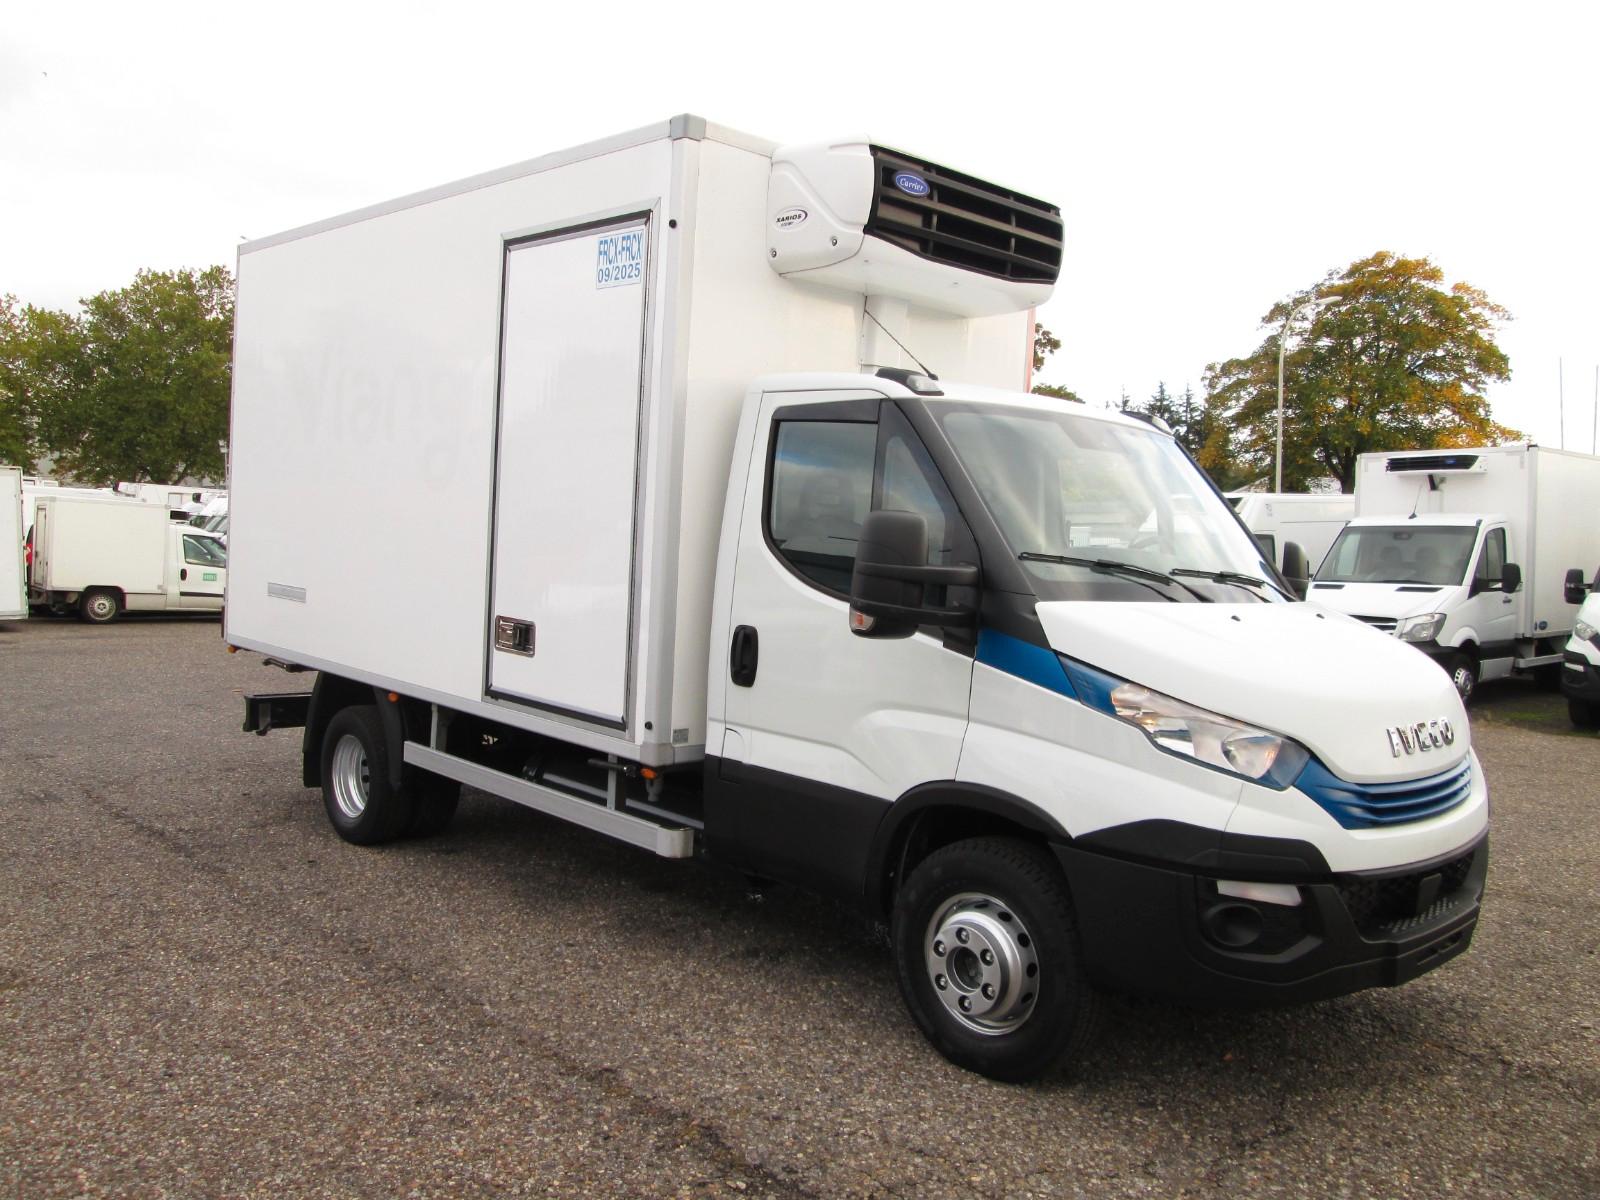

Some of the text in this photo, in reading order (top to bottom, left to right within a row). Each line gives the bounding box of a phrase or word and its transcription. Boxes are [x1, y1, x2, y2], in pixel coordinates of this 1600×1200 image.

[900, 178, 924, 191] Carrier
[599, 232, 642, 265] FRCX-FRCX
[598, 263, 640, 283] 09/2025
[1386, 718, 1454, 758] IVECO
